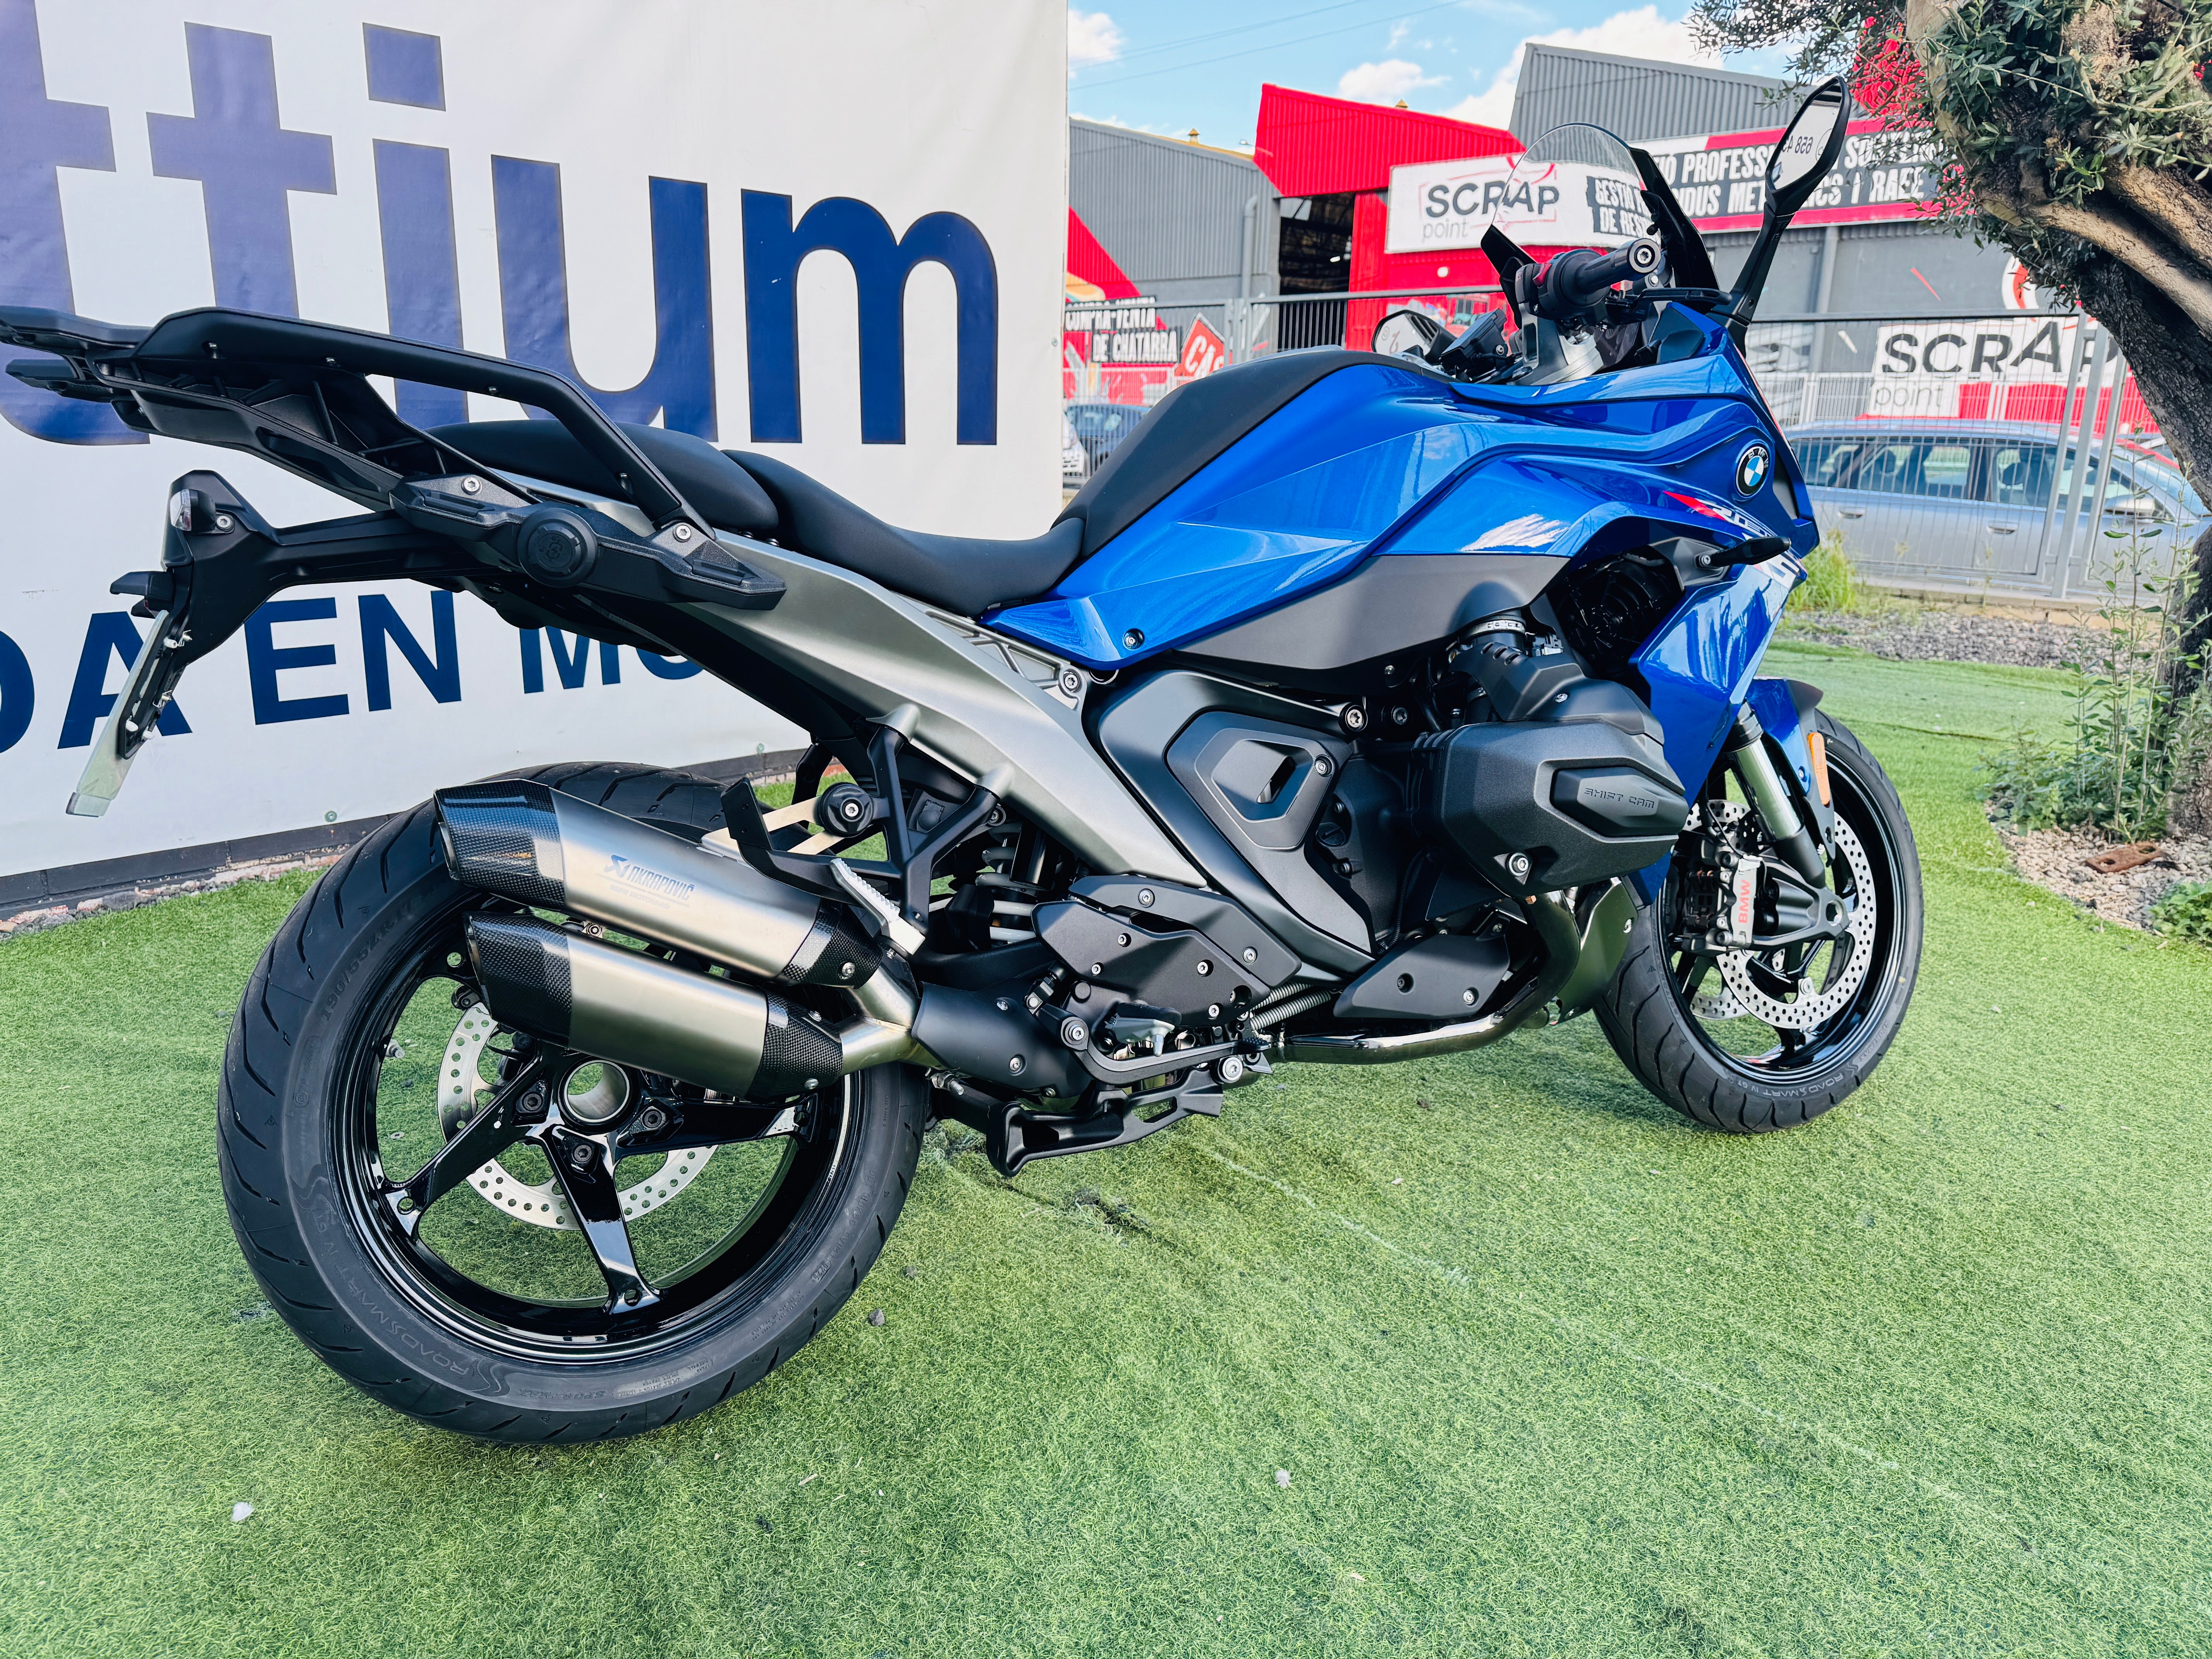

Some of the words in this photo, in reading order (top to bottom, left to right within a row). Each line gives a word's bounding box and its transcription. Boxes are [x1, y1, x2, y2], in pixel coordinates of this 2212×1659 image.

[1426, 180, 1559, 218] SCRAP
[1869, 167, 1924, 202] RAEE
[1422, 218, 1468, 243] point
[1599, 207, 1618, 233] DE
[1093, 333, 1108, 362] DE
[1113, 331, 1177, 362] CHATARRA
[1873, 382, 1943, 409] point
[1748, 447, 1769, 469] BMW
[244, 591, 462, 725] EN
[1584, 788, 1623, 802] SHIFT
[1630, 796, 1654, 809] CAM
[1738, 879, 1751, 924] BMW
[1762, 1072, 1844, 1097] ROADSMART
[334, 1264, 470, 1376] ROADSMART
